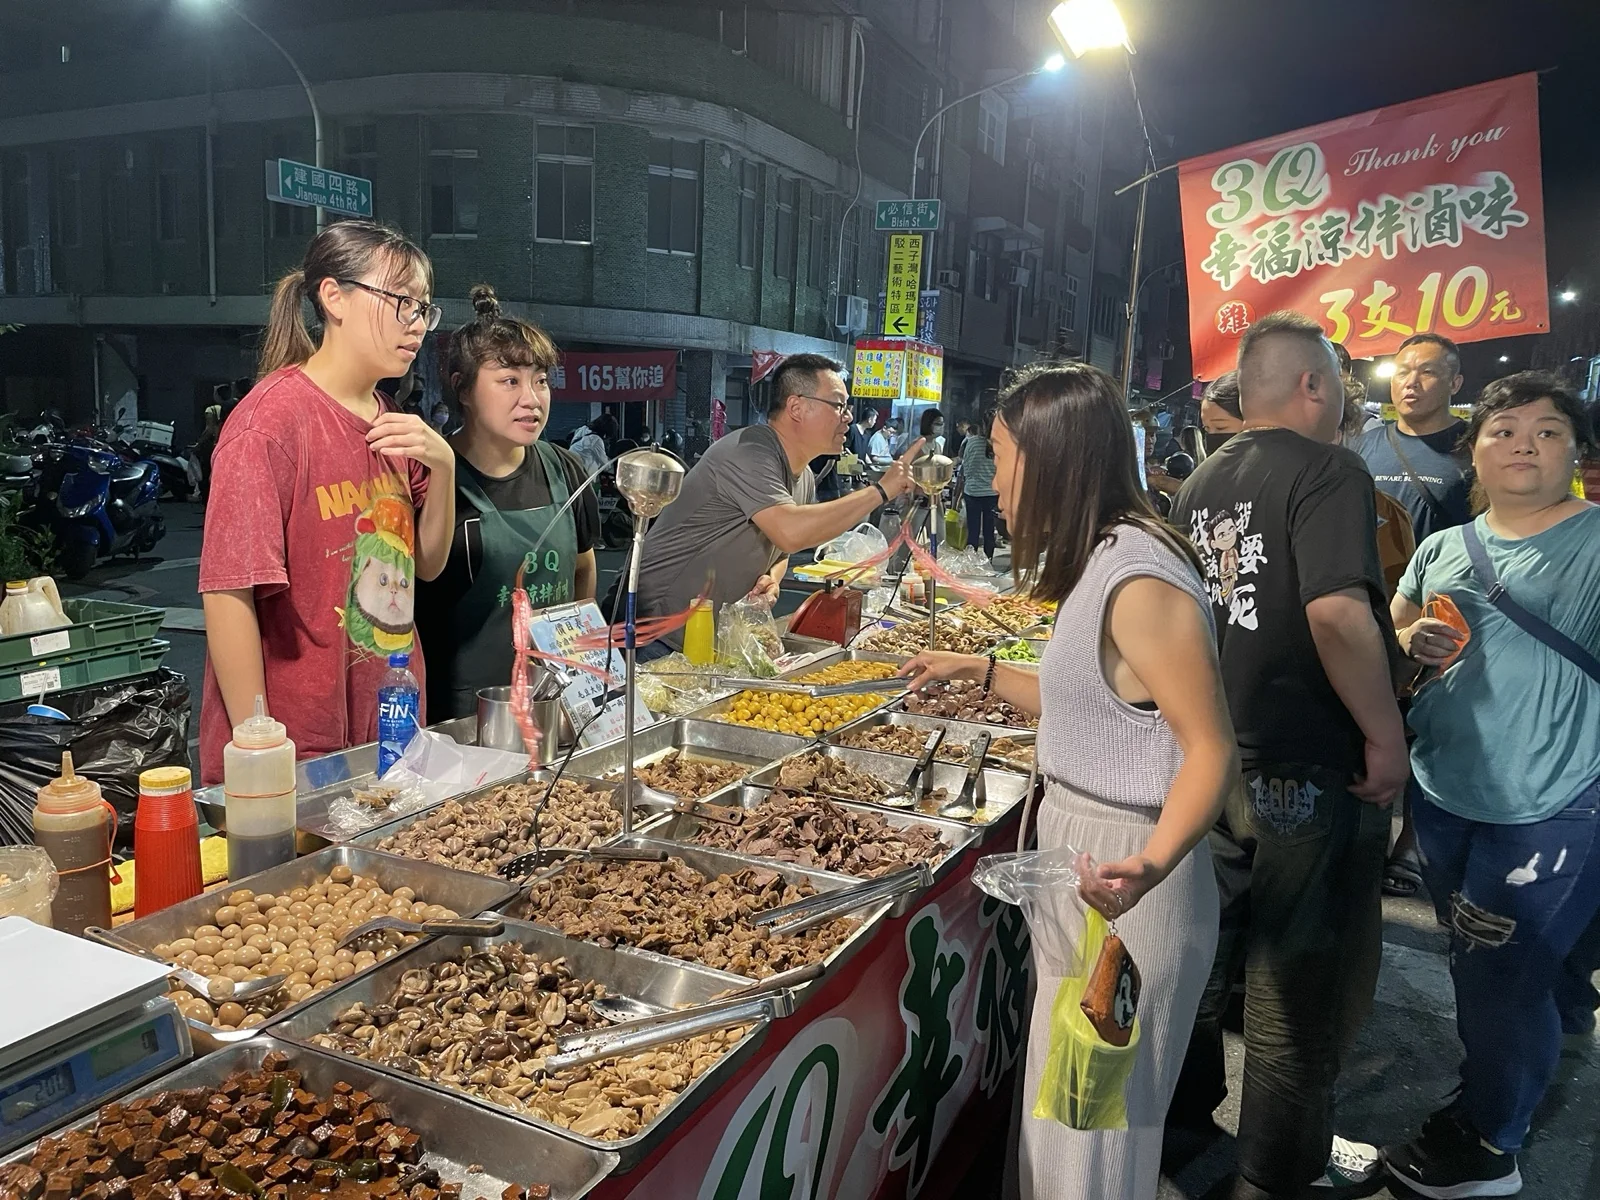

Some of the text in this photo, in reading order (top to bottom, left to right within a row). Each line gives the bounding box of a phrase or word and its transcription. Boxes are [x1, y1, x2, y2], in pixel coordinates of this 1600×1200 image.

[1344, 124, 1510, 176] Thank you
[294, 167, 358, 196] 建國四路
[1209, 144, 1328, 226] 3Q
[295, 186, 358, 210] Jianguo 4th Rd
[887, 202, 928, 216] 必信街
[891, 216, 920, 228] Bisin St
[1203, 174, 1526, 289] 幸福涼拌滷味
[889, 237, 905, 314] 駁二藝術特區
[904, 238, 920, 314] 西子灣、哈瑪星
[544, 549, 560, 572] Q
[496, 579, 569, 608] 幸涼拌滷味
[380, 702, 409, 719] FIN
